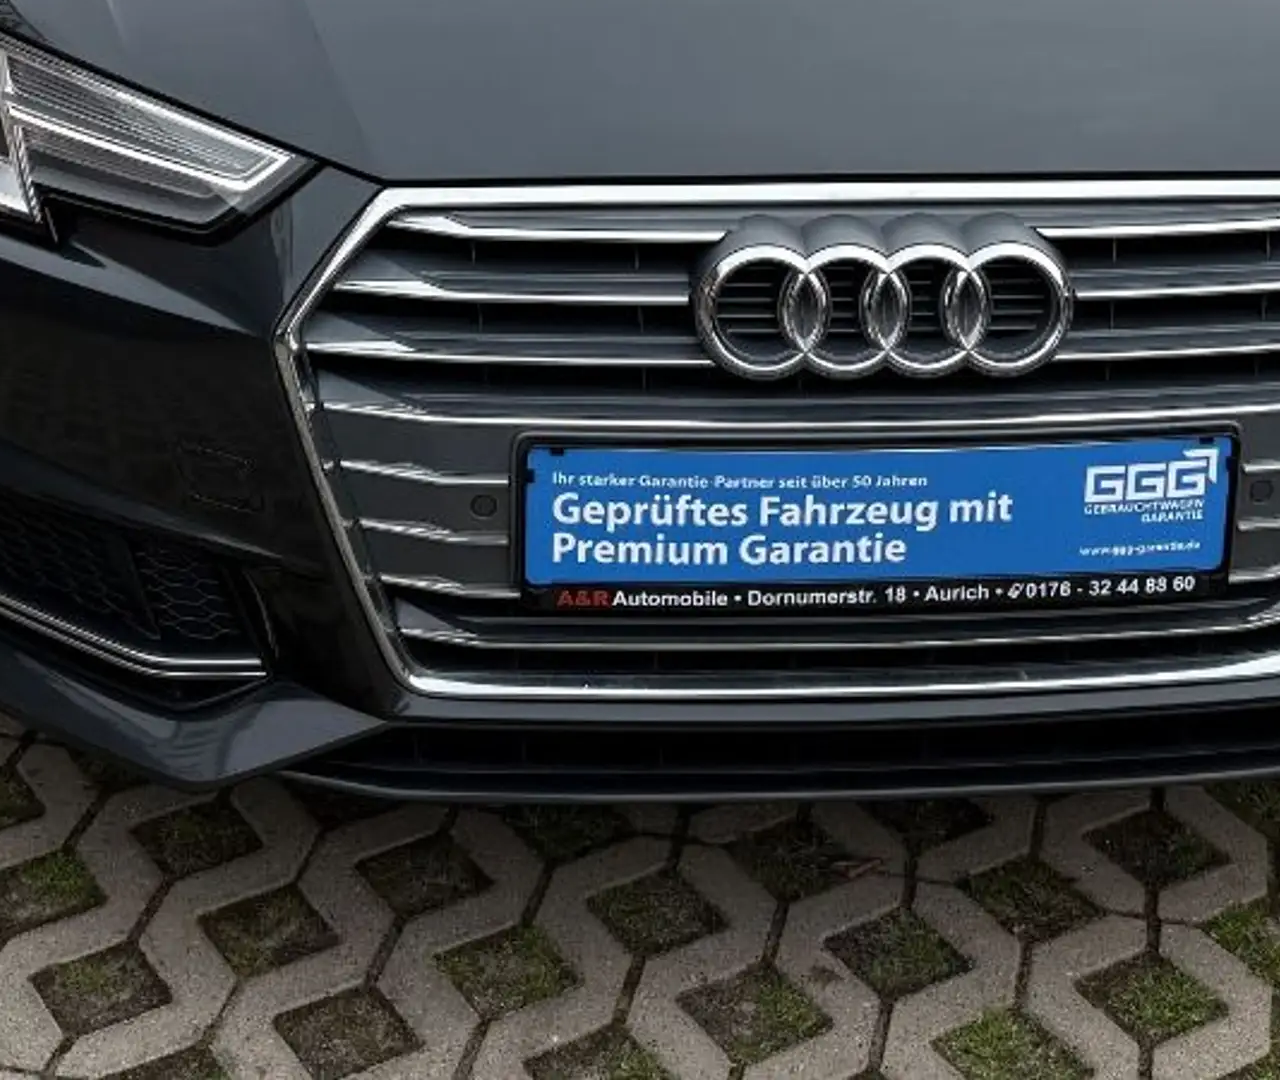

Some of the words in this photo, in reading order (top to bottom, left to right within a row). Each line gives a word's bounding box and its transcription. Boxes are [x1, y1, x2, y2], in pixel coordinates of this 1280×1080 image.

[553, 472, 574, 485] Ihr
[579, 472, 634, 487] starker
[779, 475, 806, 488] seit
[811, 475, 847, 488] über
[852, 475, 871, 487] 50
[876, 475, 928, 488] Jahren
[1084, 458, 1207, 503] GGG
[553, 492, 748, 533] Geprüftes
[760, 493, 938, 531] Fahrzeug
[949, 490, 1013, 523] mit
[553, 533, 728, 565] Premium
[739, 532, 907, 565] Garantie
[557, 591, 611, 607] A&R
[612, 590, 728, 607] Automobile
[748, 587, 877, 606] Dornumerstr.
[885, 586, 906, 602] 18
[924, 584, 990, 602] Aurich
[1088, 579, 1112, 596] 32
[1116, 578, 1140, 595] 44
[1145, 576, 1167, 593] 88
[1172, 575, 1196, 591] 60
